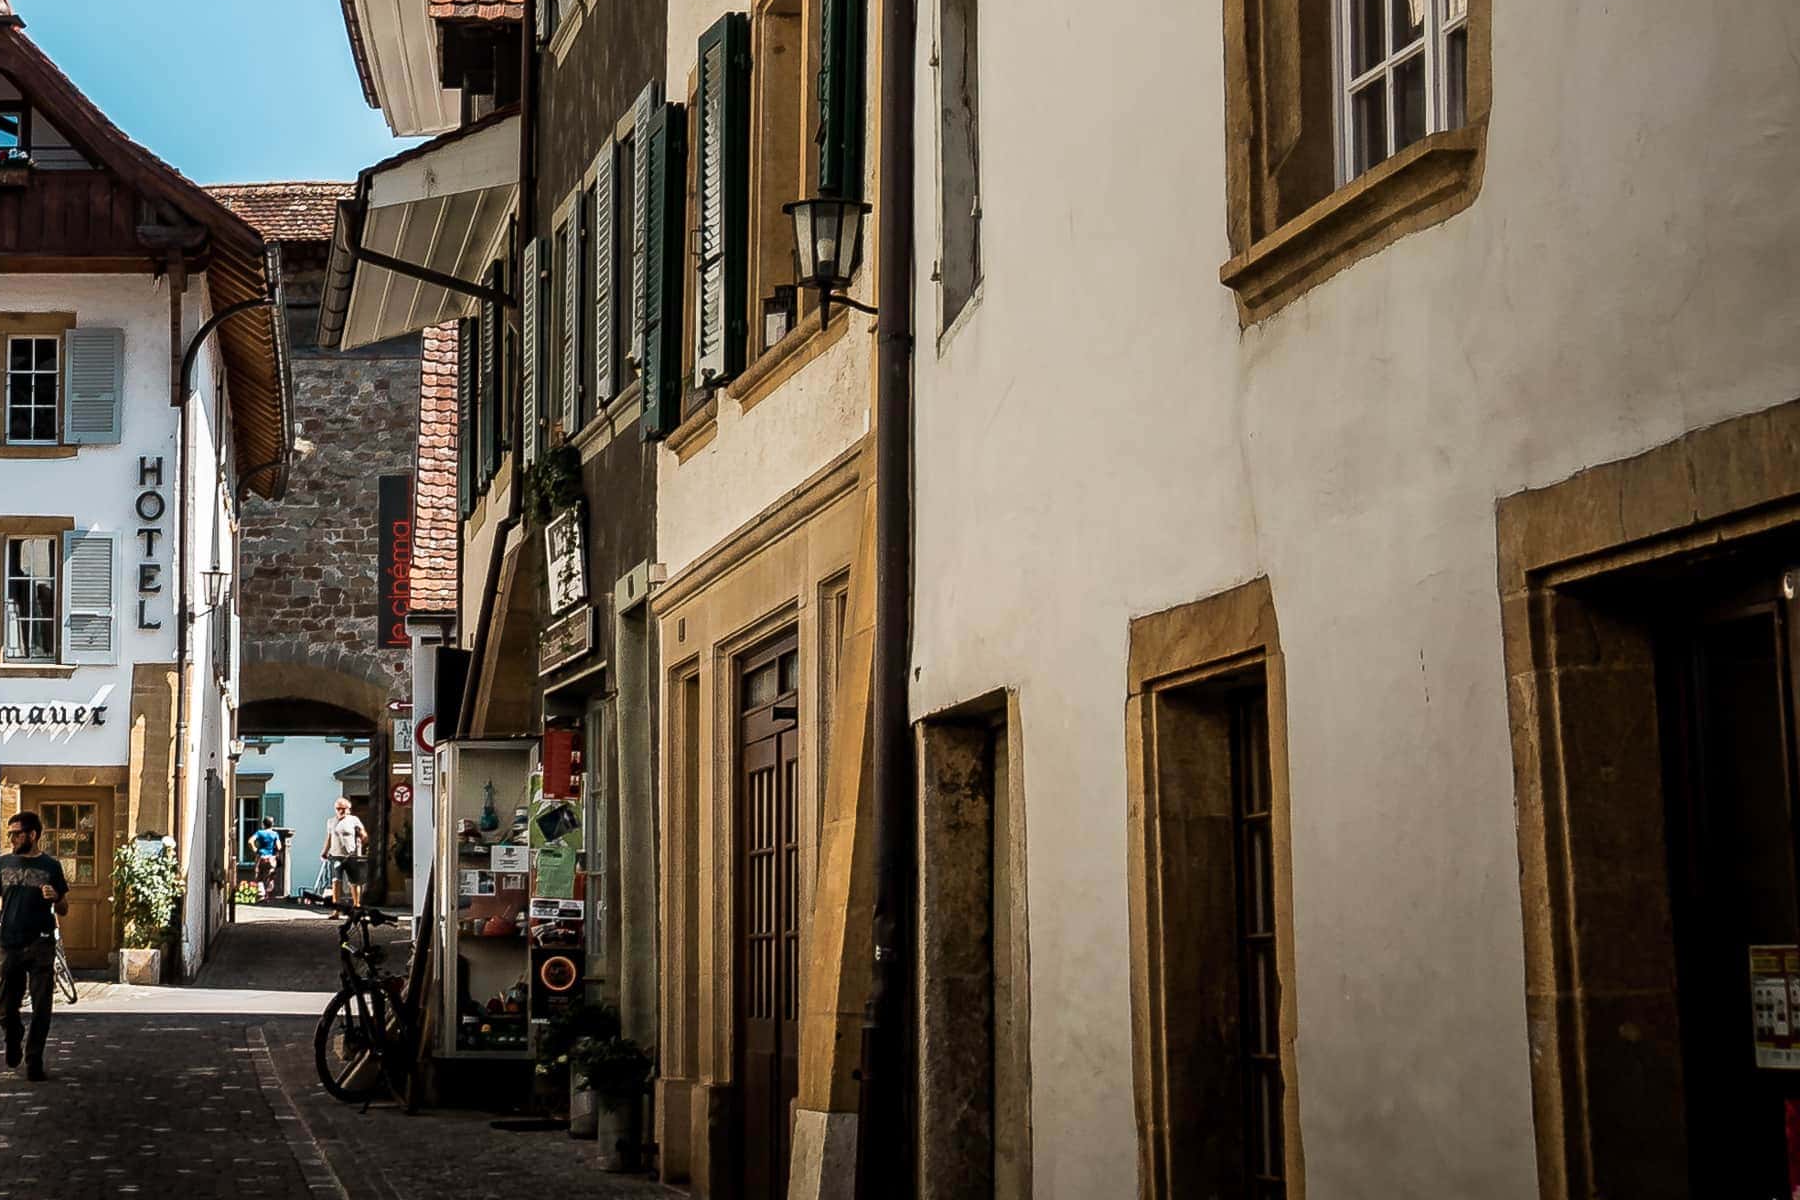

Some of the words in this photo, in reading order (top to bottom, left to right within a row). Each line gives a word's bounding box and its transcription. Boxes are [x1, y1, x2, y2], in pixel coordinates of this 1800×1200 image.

[135, 456, 166, 630] HOTEL
[386, 520, 411, 616] cinéma
[386, 623, 410, 645] le
